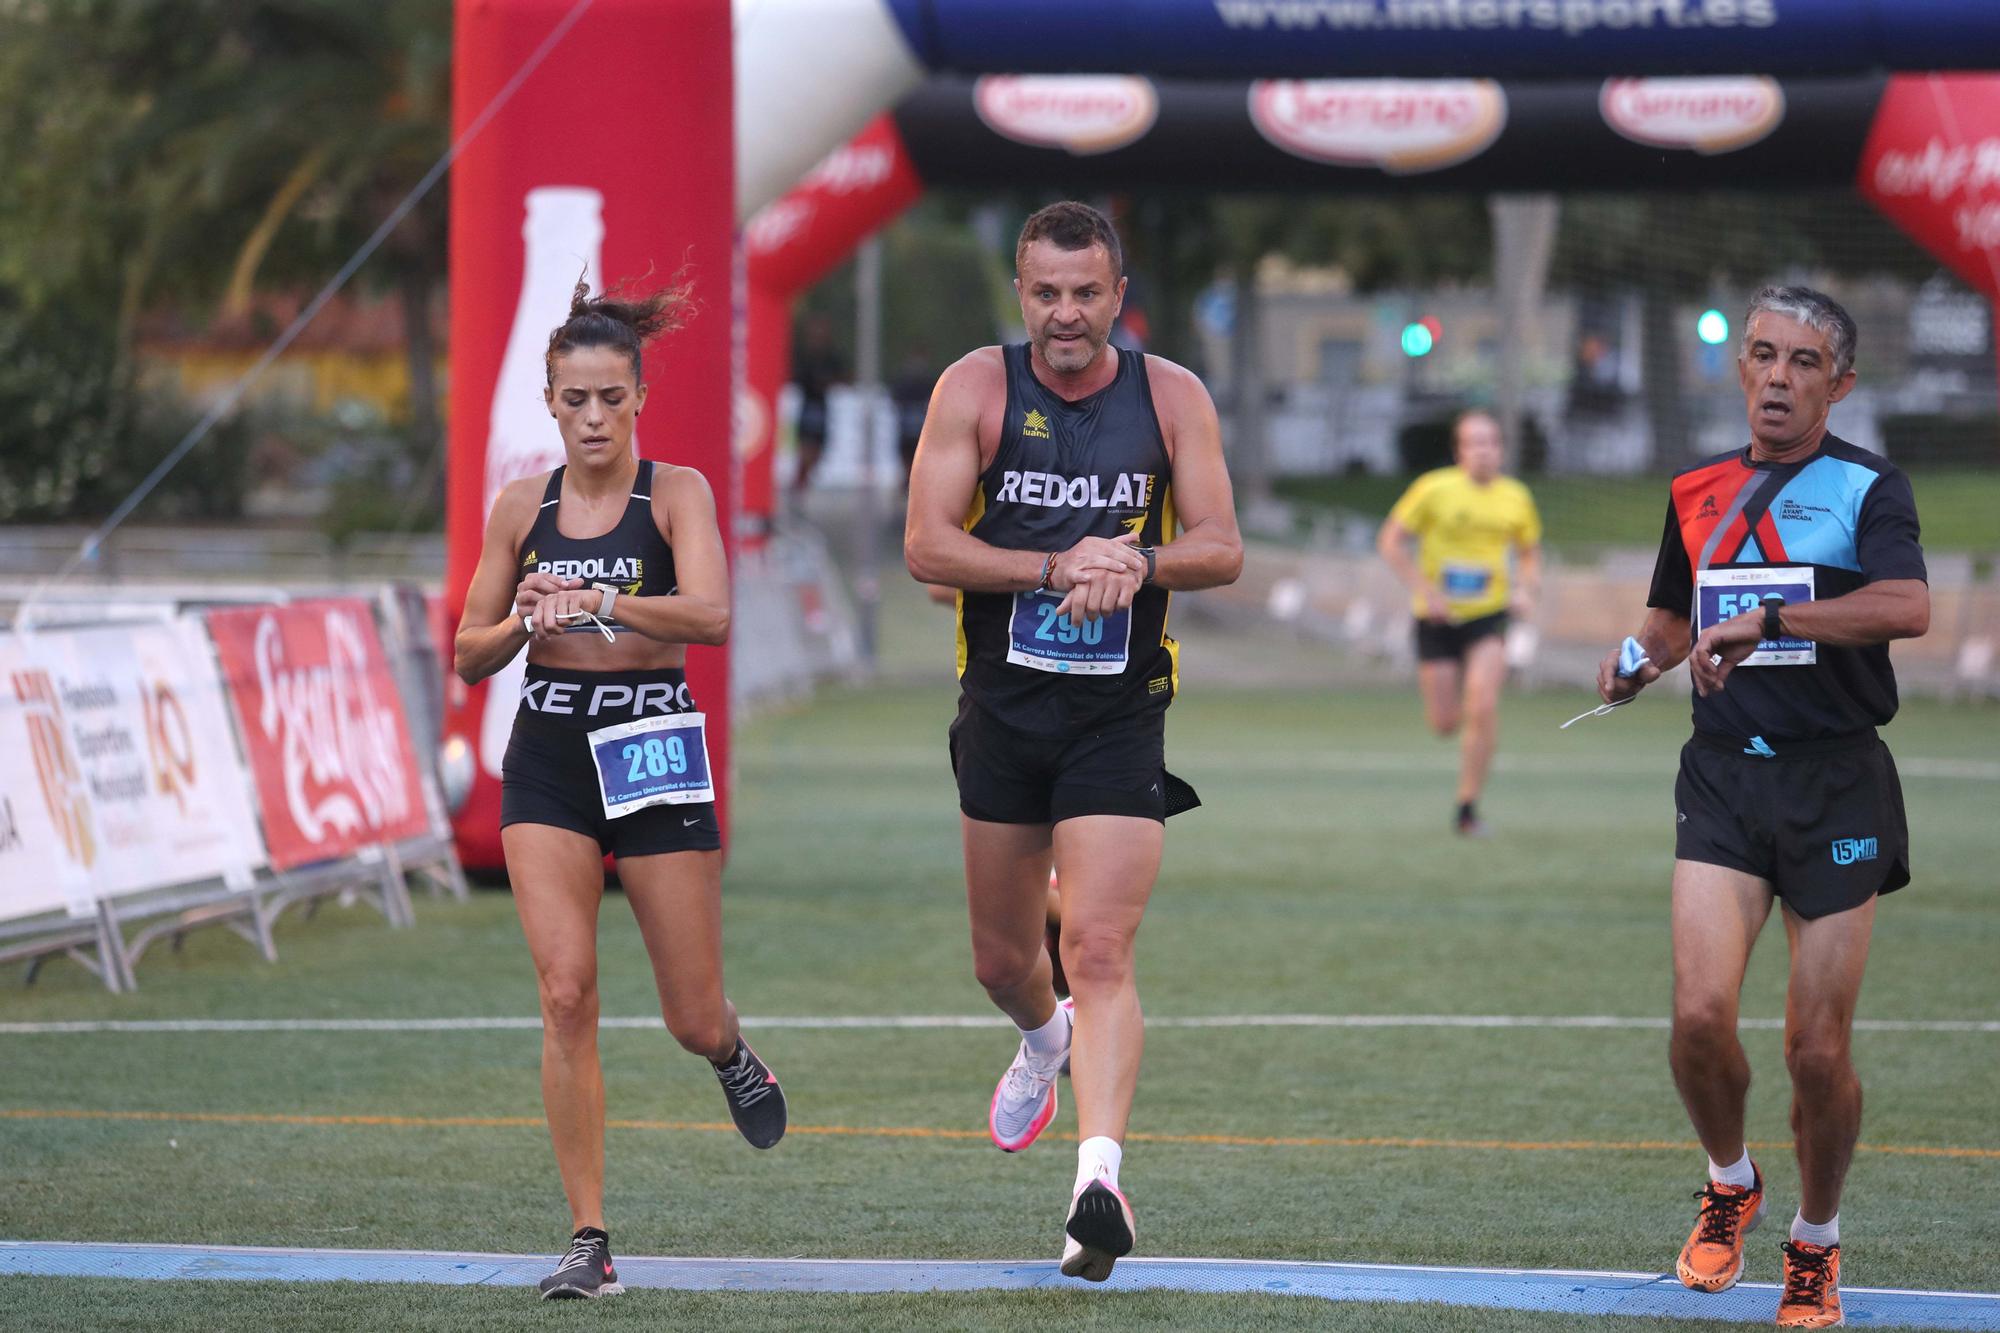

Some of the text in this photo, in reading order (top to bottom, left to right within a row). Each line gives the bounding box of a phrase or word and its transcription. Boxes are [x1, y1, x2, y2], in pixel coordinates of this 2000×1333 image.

[1217, 0, 1777, 35] www.intersport.es
[1023, 428, 1049, 439] luanvi
[996, 471, 1147, 508] REDOLAT
[1145, 474, 1156, 508] TEAM
[538, 558, 637, 579] REDOLAT
[1719, 592, 1784, 623] 53
[1035, 603, 1103, 645] 290
[1022, 643, 1045, 655] Carrera
[1046, 649, 1084, 659] Universitat
[622, 736, 688, 783] 289
[608, 796, 617, 804] IX
[618, 791, 642, 801] Carrera
[643, 784, 678, 794] Universitat
